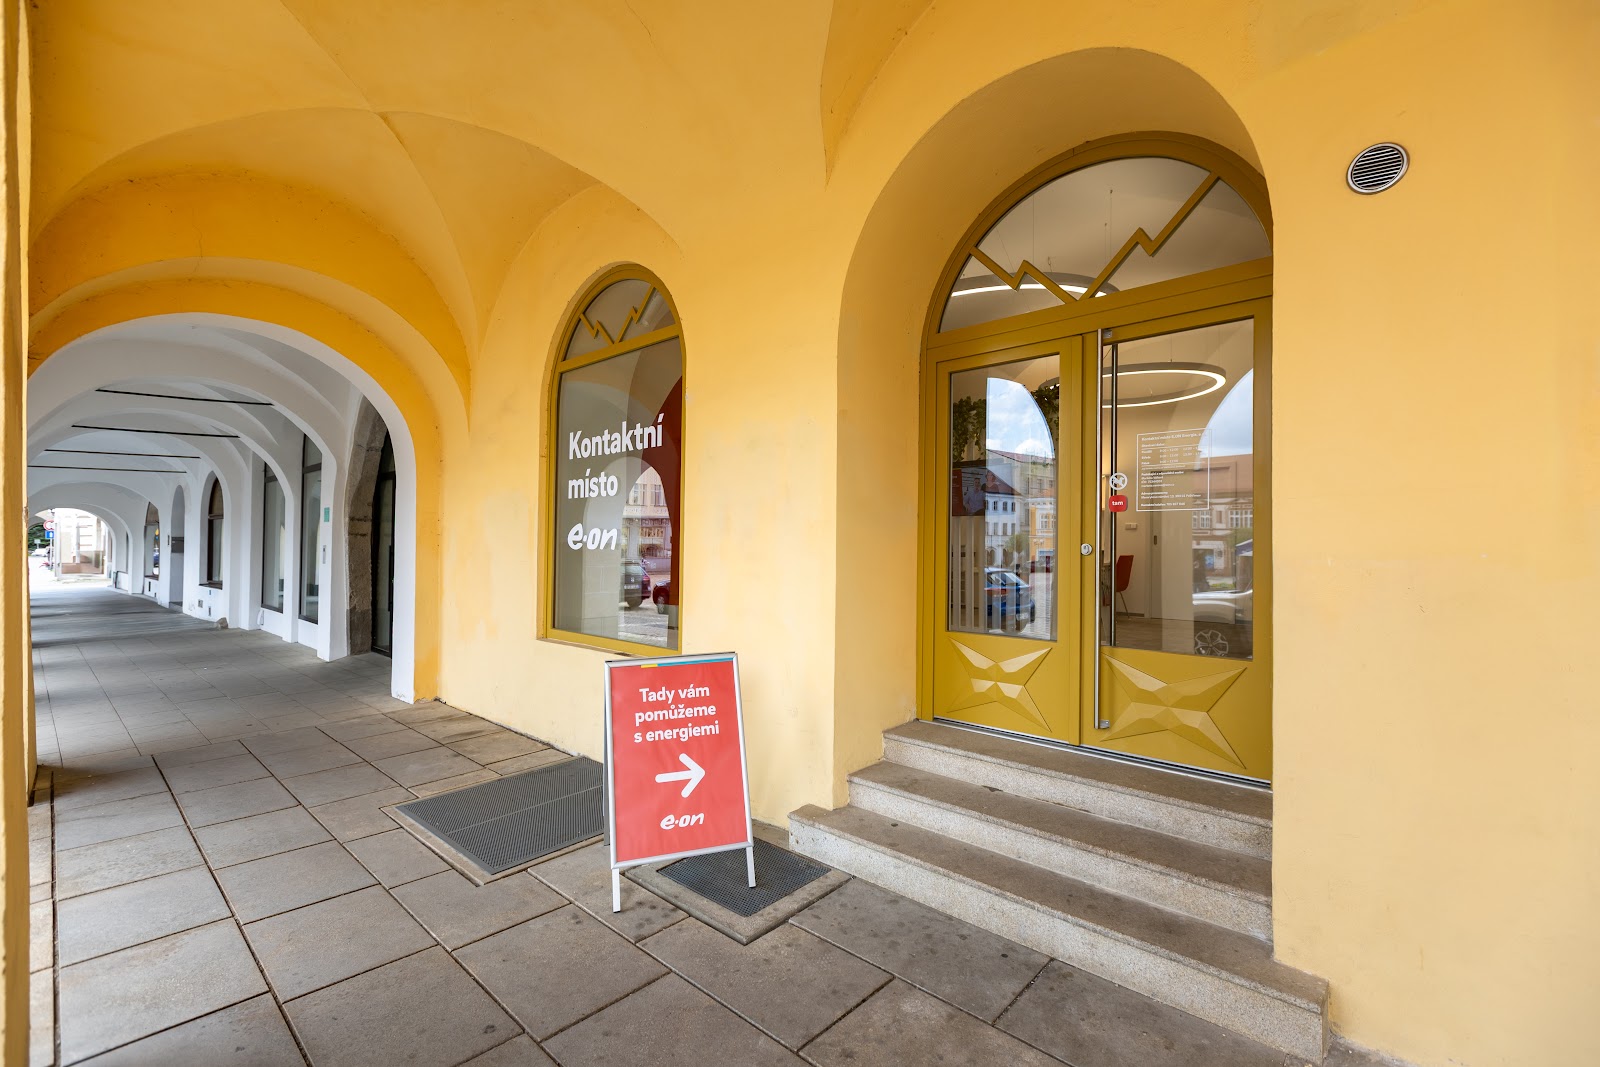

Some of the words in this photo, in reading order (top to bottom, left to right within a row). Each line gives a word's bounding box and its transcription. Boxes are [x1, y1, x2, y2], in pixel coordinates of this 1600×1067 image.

[569, 413, 664, 460] Kontaktní
[568, 468, 618, 499] místo
[639, 687, 675, 704] Tady
[678, 684, 710, 699] vám
[635, 704, 716, 726] pomůžeme
[634, 733, 643, 743] s
[646, 720, 719, 742] energiemi
